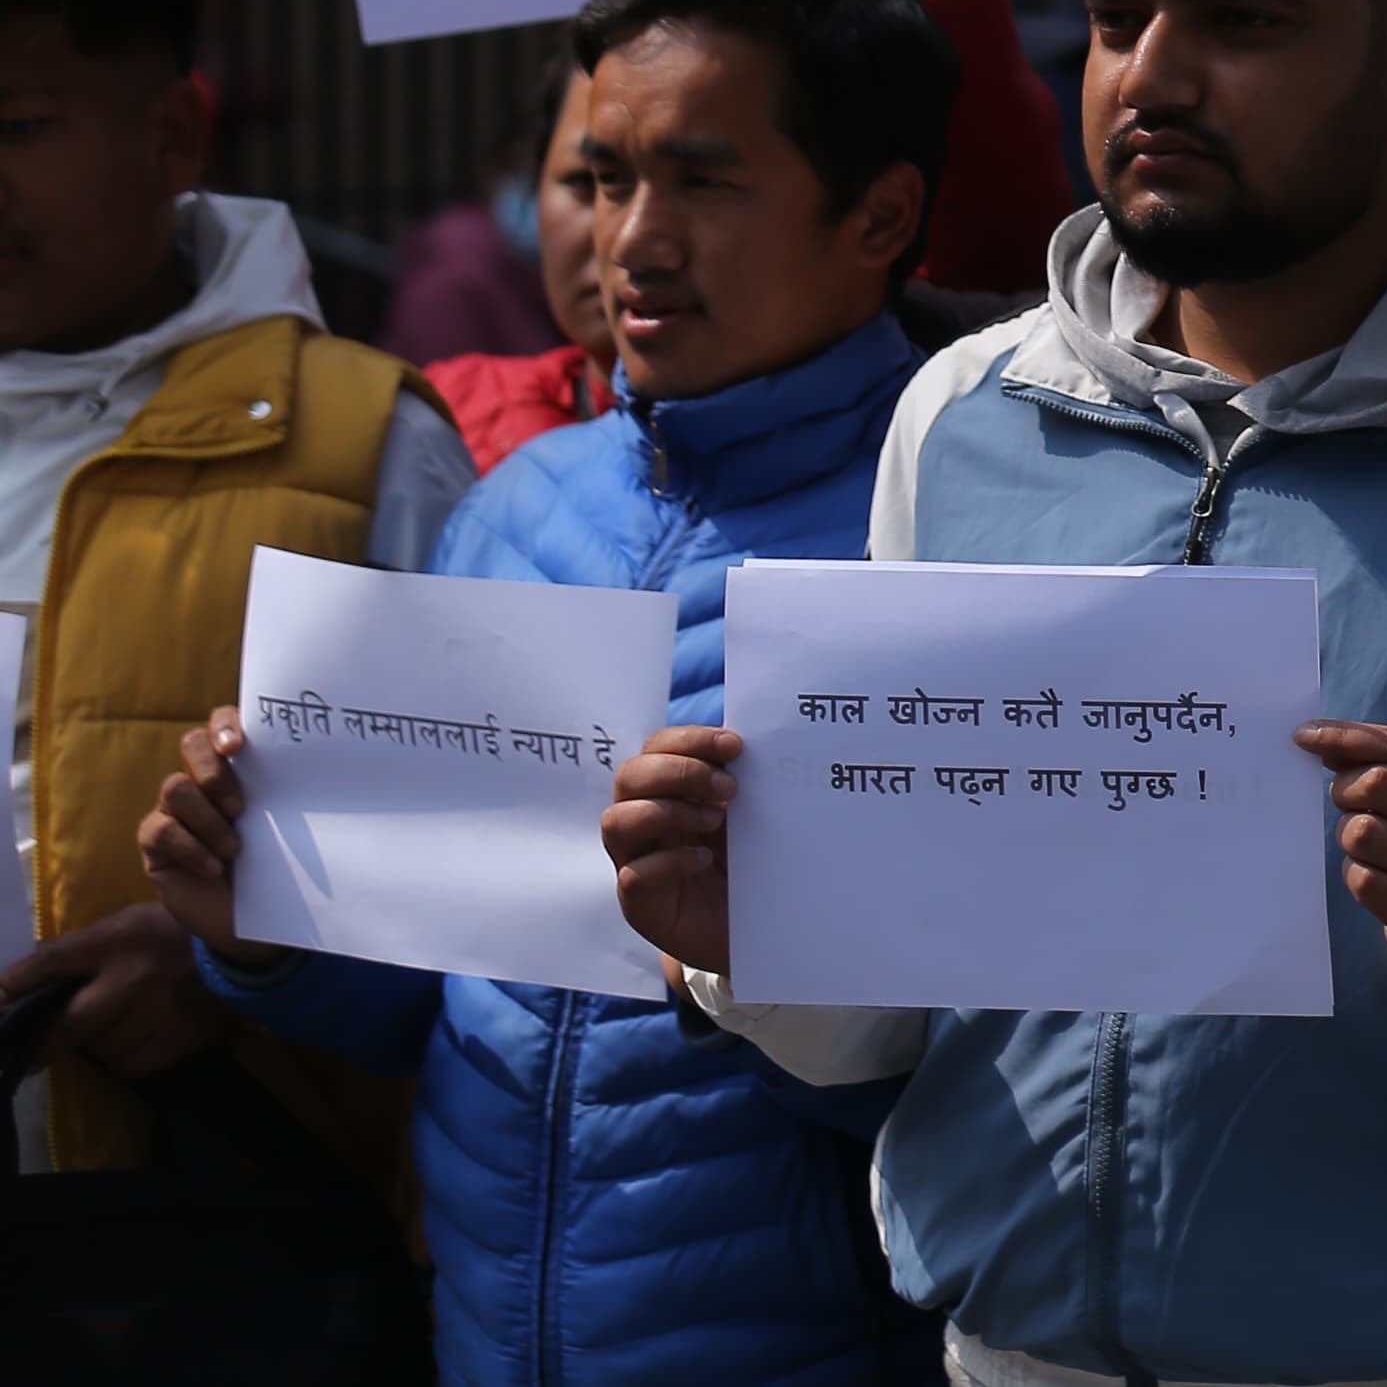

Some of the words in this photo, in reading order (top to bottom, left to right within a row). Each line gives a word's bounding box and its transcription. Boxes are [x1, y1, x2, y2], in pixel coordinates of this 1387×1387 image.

[257, 689, 334, 743] प्रकृति
[340, 707, 502, 757] लम्साललाई
[509, 728, 584, 767] न्याय
[592, 724, 617, 771] दे
[797, 693, 870, 724] काल
[886, 686, 985, 727] खोज्न
[1001, 687, 1064, 730] कतै
[830, 762, 917, 795] भारत
[933, 766, 1011, 806] पढ्न
[1027, 769, 1083, 798] गए
[1099, 770, 1178, 812] पुग्छ
[1198, 769, 1207, 801] !
